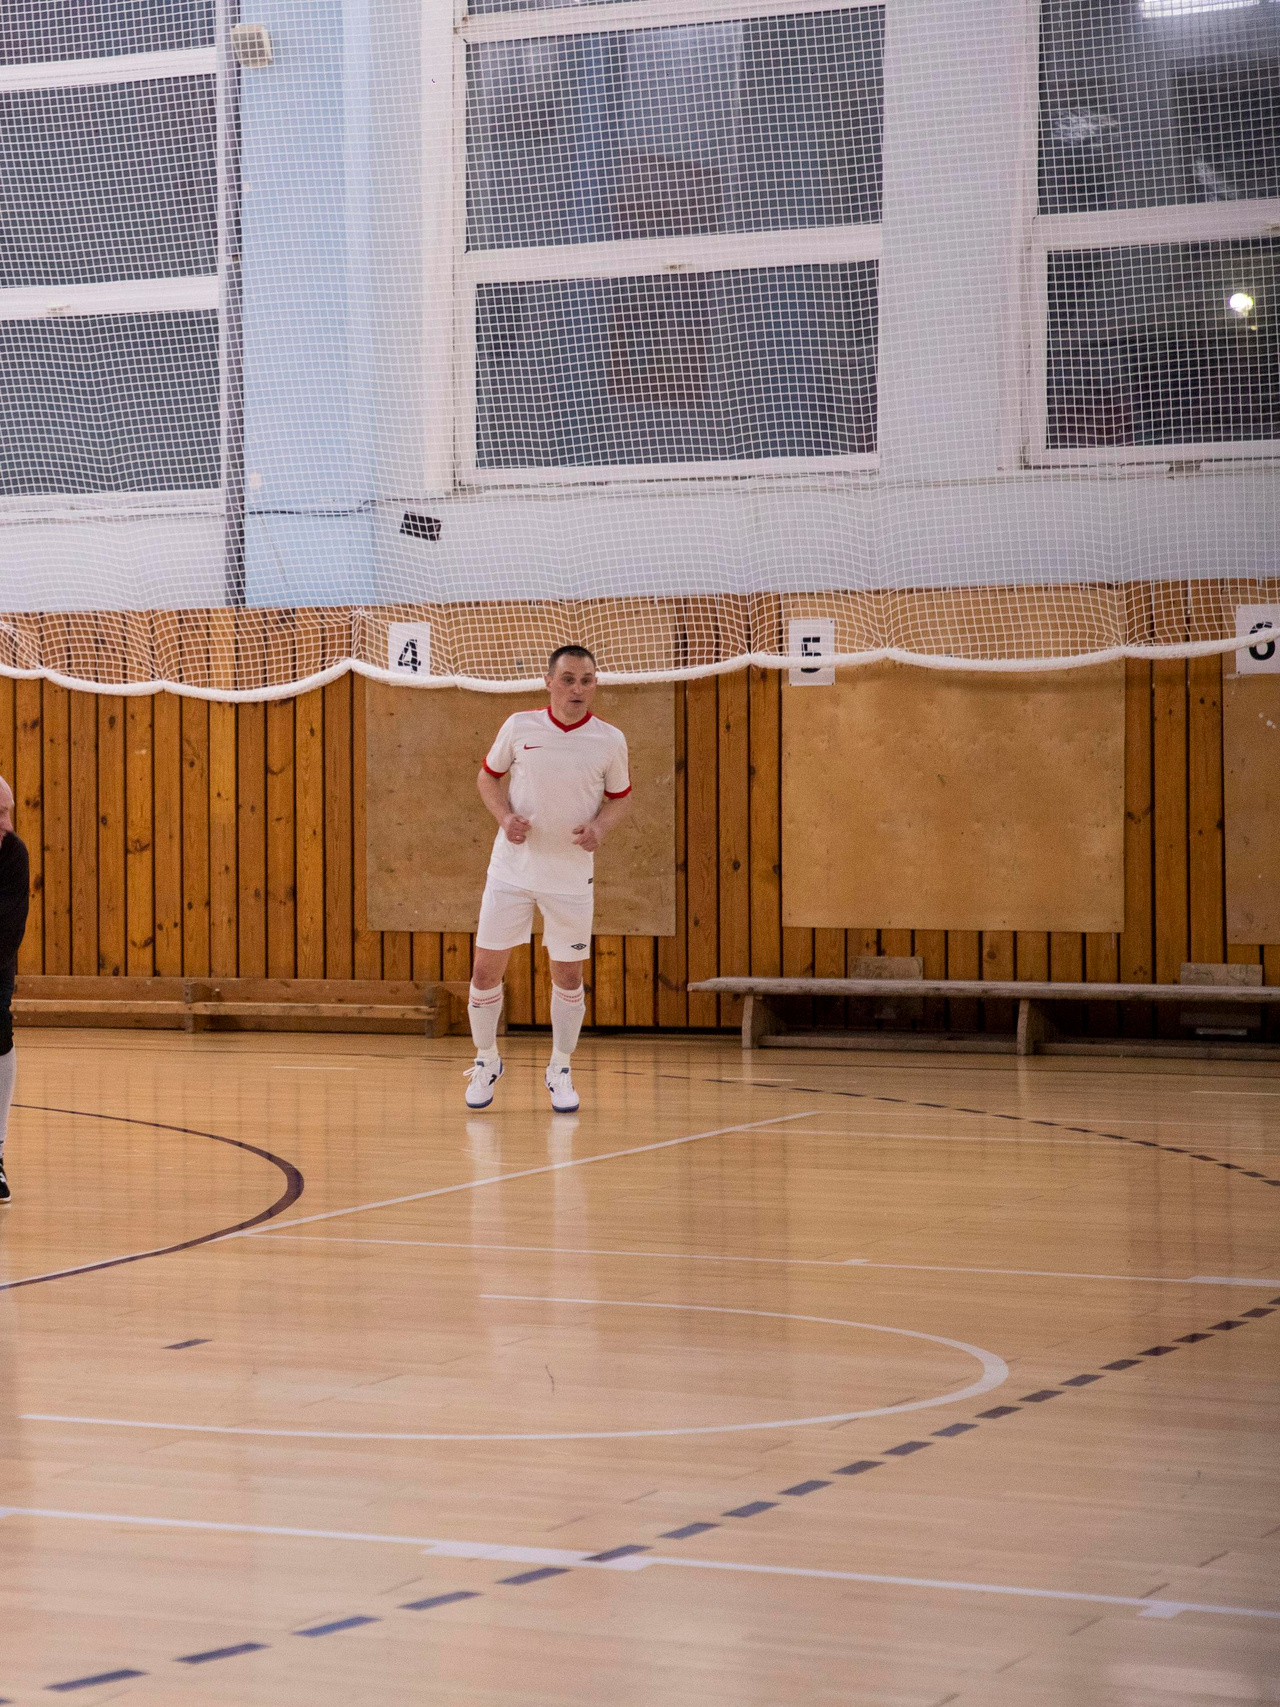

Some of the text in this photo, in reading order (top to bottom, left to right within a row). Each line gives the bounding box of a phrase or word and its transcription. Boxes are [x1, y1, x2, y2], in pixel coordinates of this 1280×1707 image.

[397, 638, 422, 674] 4
[800, 636, 823, 674] 5
[1249, 621, 1276, 661] 6
